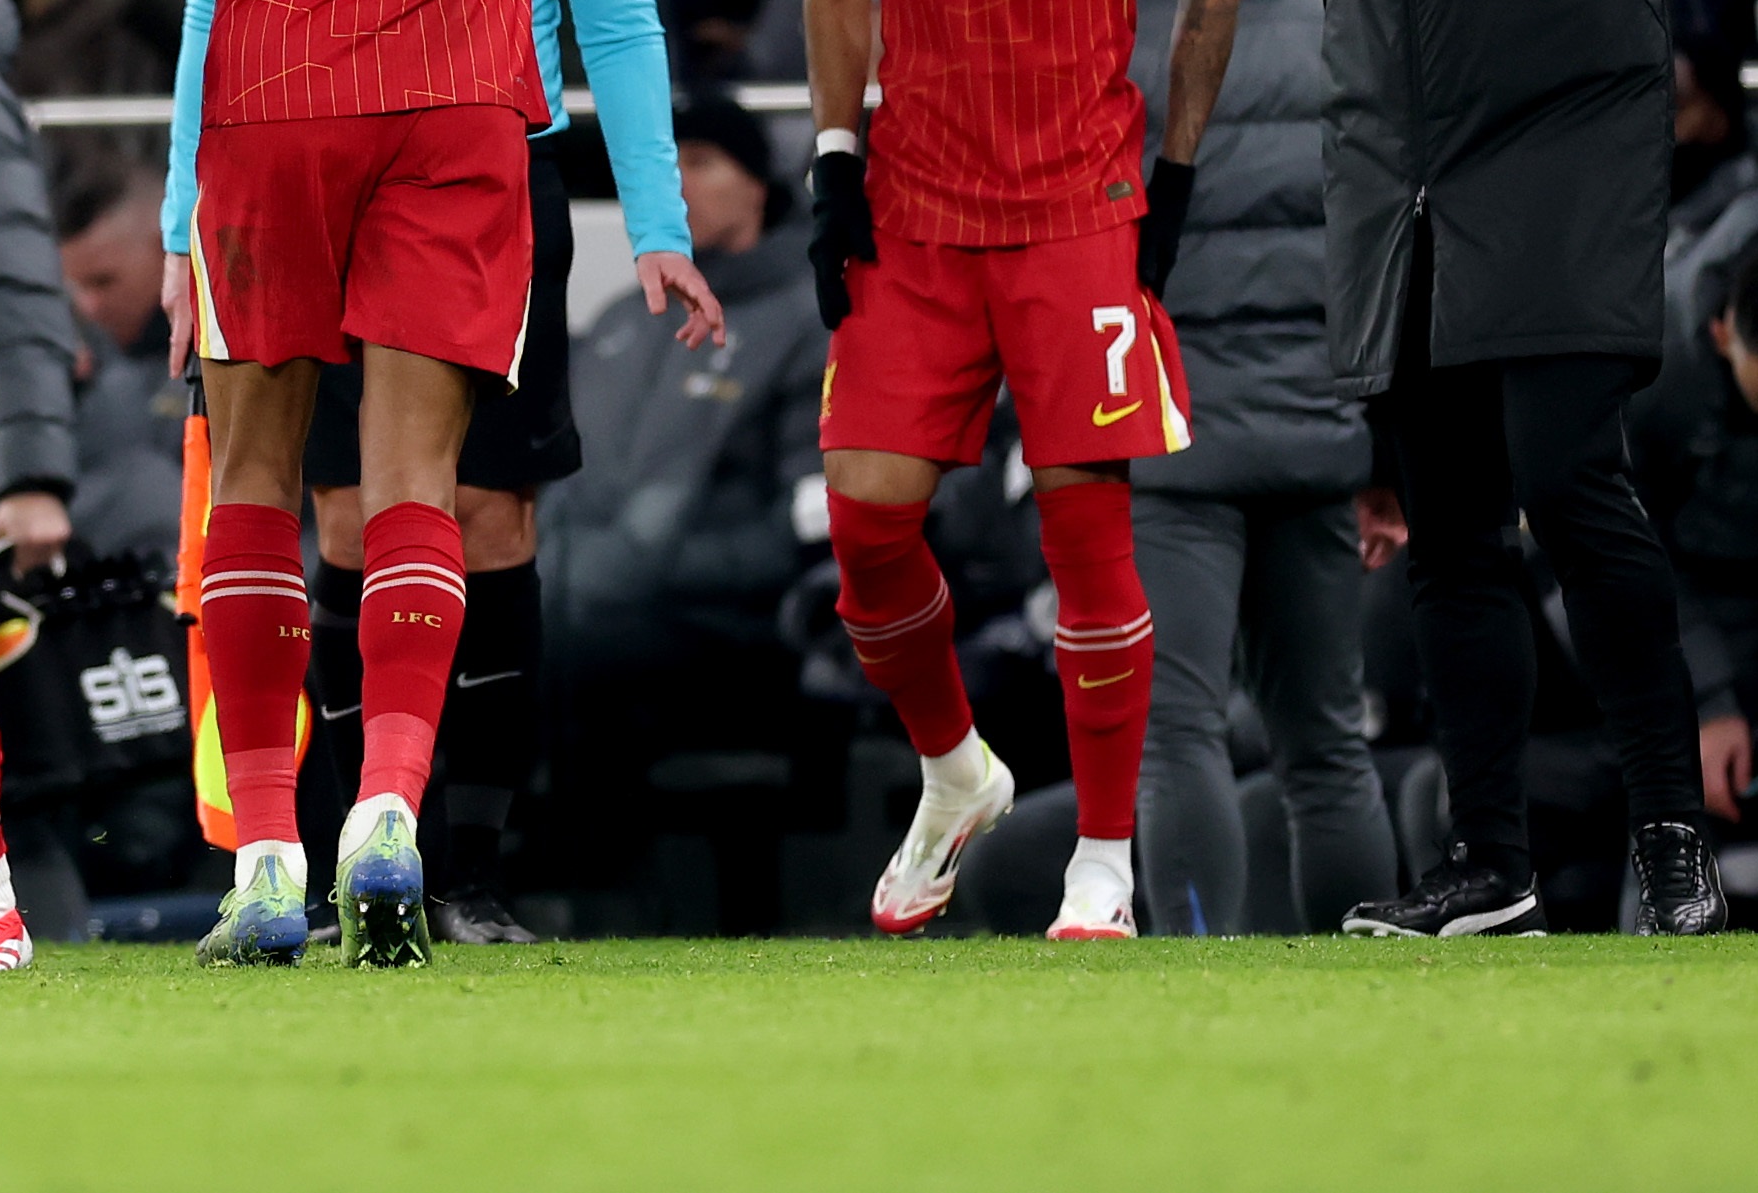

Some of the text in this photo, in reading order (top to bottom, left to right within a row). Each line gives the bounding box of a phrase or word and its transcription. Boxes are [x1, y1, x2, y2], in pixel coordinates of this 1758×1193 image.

[1092, 305, 1136, 396] 7
[392, 611, 442, 628] LFC
[278, 625, 310, 641] LFC
